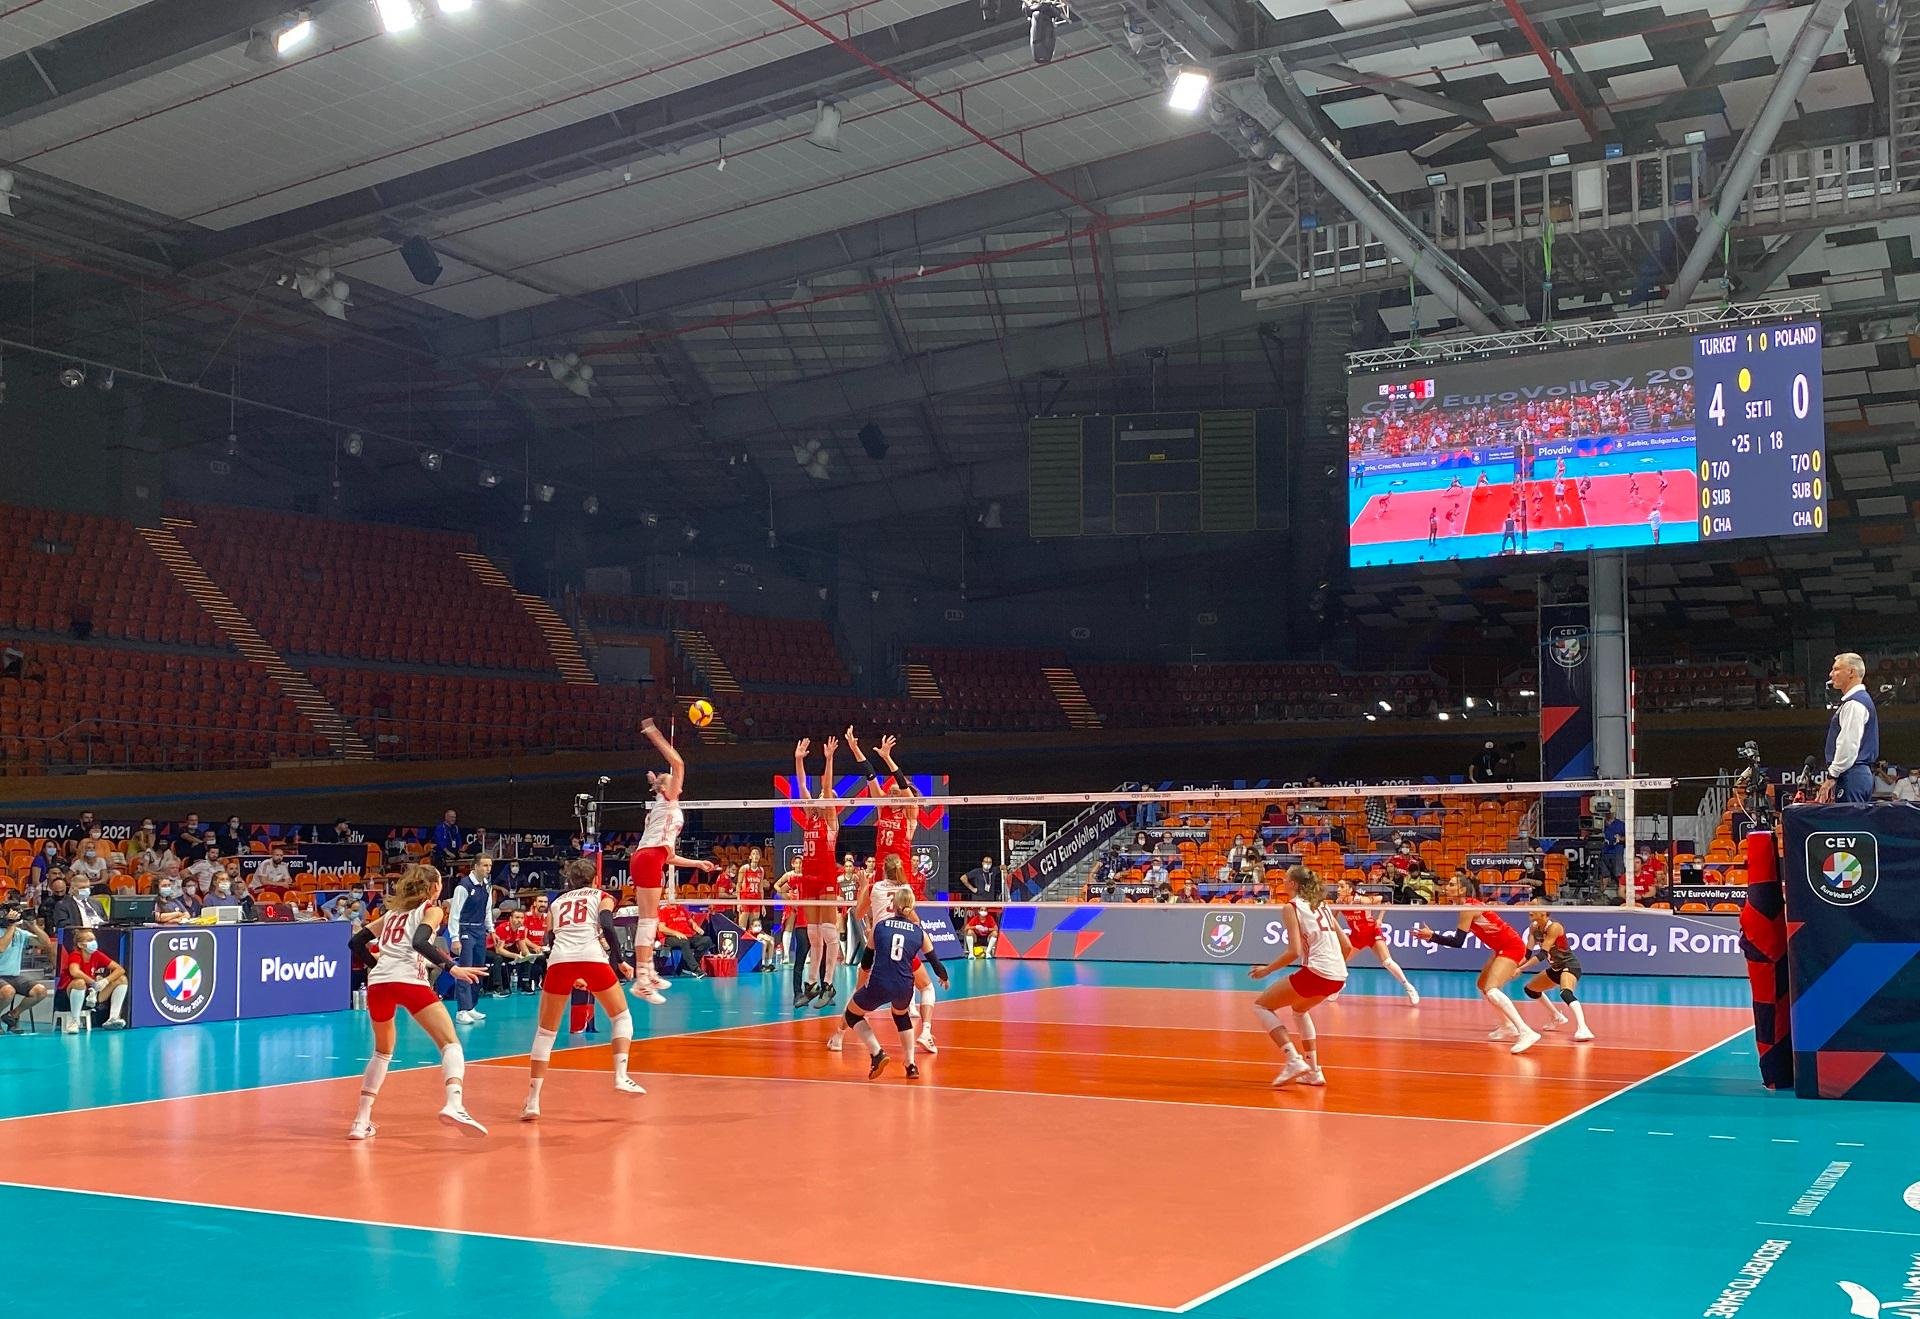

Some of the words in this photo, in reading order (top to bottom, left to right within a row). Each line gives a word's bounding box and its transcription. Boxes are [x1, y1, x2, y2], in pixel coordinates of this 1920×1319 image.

[1700, 336, 1737, 356] TURKEY
[1746, 334, 1752, 352] 1
[1760, 332, 1768, 352] 0
[1774, 326, 1816, 348] POLAND
[1442, 376, 1634, 407] EuroVolley
[1792, 374, 1809, 419] 0
[1708, 382, 1726, 426] 4
[1746, 400, 1763, 418] SET
[1770, 430, 1783, 450] 18
[1538, 446, 1572, 457] Plovdiv
[1790, 454, 1810, 474] T/O
[1812, 450, 1820, 472] 0
[1702, 460, 1709, 482] 0
[1711, 461, 1730, 480] T/O
[1702, 488, 1710, 508] 0
[1712, 489, 1731, 506] SUB
[1792, 482, 1811, 499] SUB
[1814, 478, 1822, 500] 0
[1702, 515, 1710, 536] 0
[1713, 518, 1732, 532] CHA
[1793, 512, 1812, 526] CHA
[1814, 506, 1822, 528] 0
[102, 826, 130, 839] 2021
[1040, 852, 1058, 876] CEV
[1058, 822, 1100, 862] EuroVolley
[1098, 808, 1117, 832] 2021
[1825, 838, 1856, 848] CEV
[1486, 858, 1523, 867] EuroVolley
[845, 892, 854, 900] 10
[1688, 890, 1730, 900] EuroVolley
[1820, 885, 1852, 899] EuroVolley
[1852, 884, 1866, 896] 2021
[558, 898, 588, 928] 26
[168, 937, 198, 951] CEV
[890, 934, 905, 962] 8
[261, 954, 337, 982] Plovdiv
[160, 996, 192, 1014] EuroVolley
[190, 994, 204, 1010] 2021
[1739, 1239, 1792, 1280] DISCOVERY
[1728, 1278, 1761, 1290] TO
[1703, 1288, 1752, 1319] SHARE
